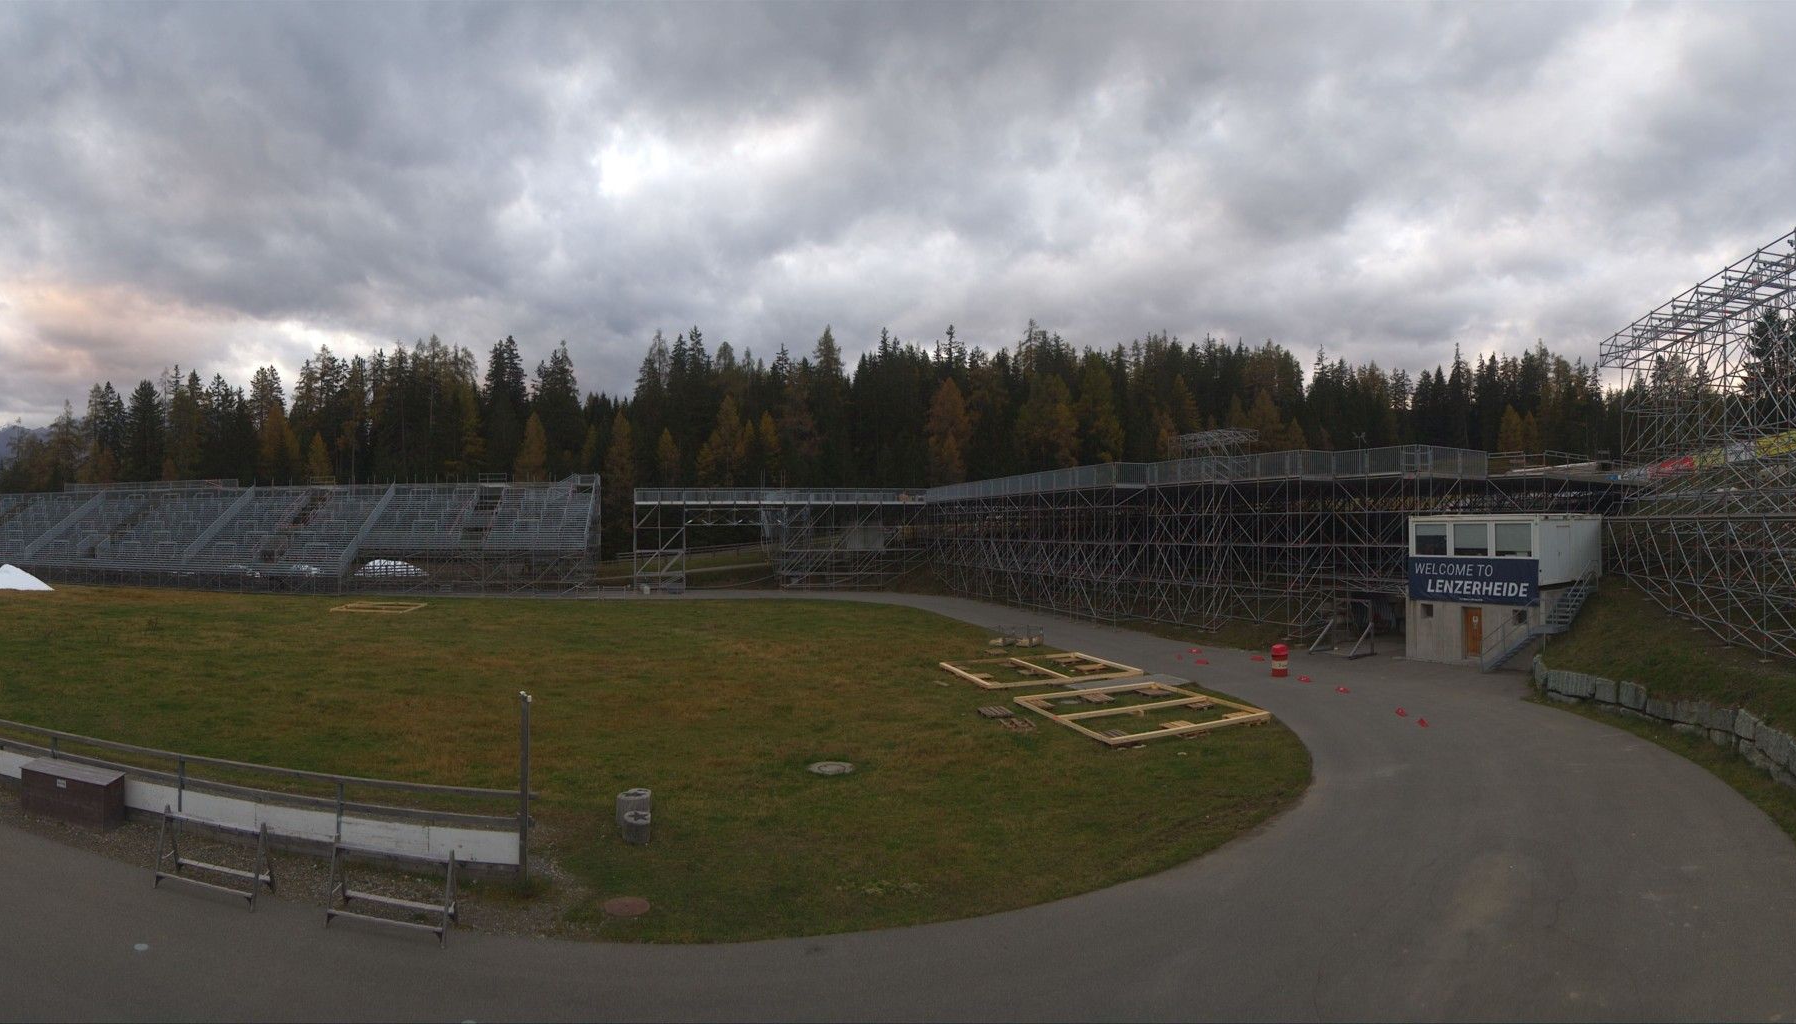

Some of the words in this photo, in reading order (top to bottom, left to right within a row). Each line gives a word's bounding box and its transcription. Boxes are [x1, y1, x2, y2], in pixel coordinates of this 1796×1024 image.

[1415, 562, 1473, 577] WELCOME
[1478, 564, 1493, 577] TO
[1427, 579, 1529, 598] LENZERHEIDE
